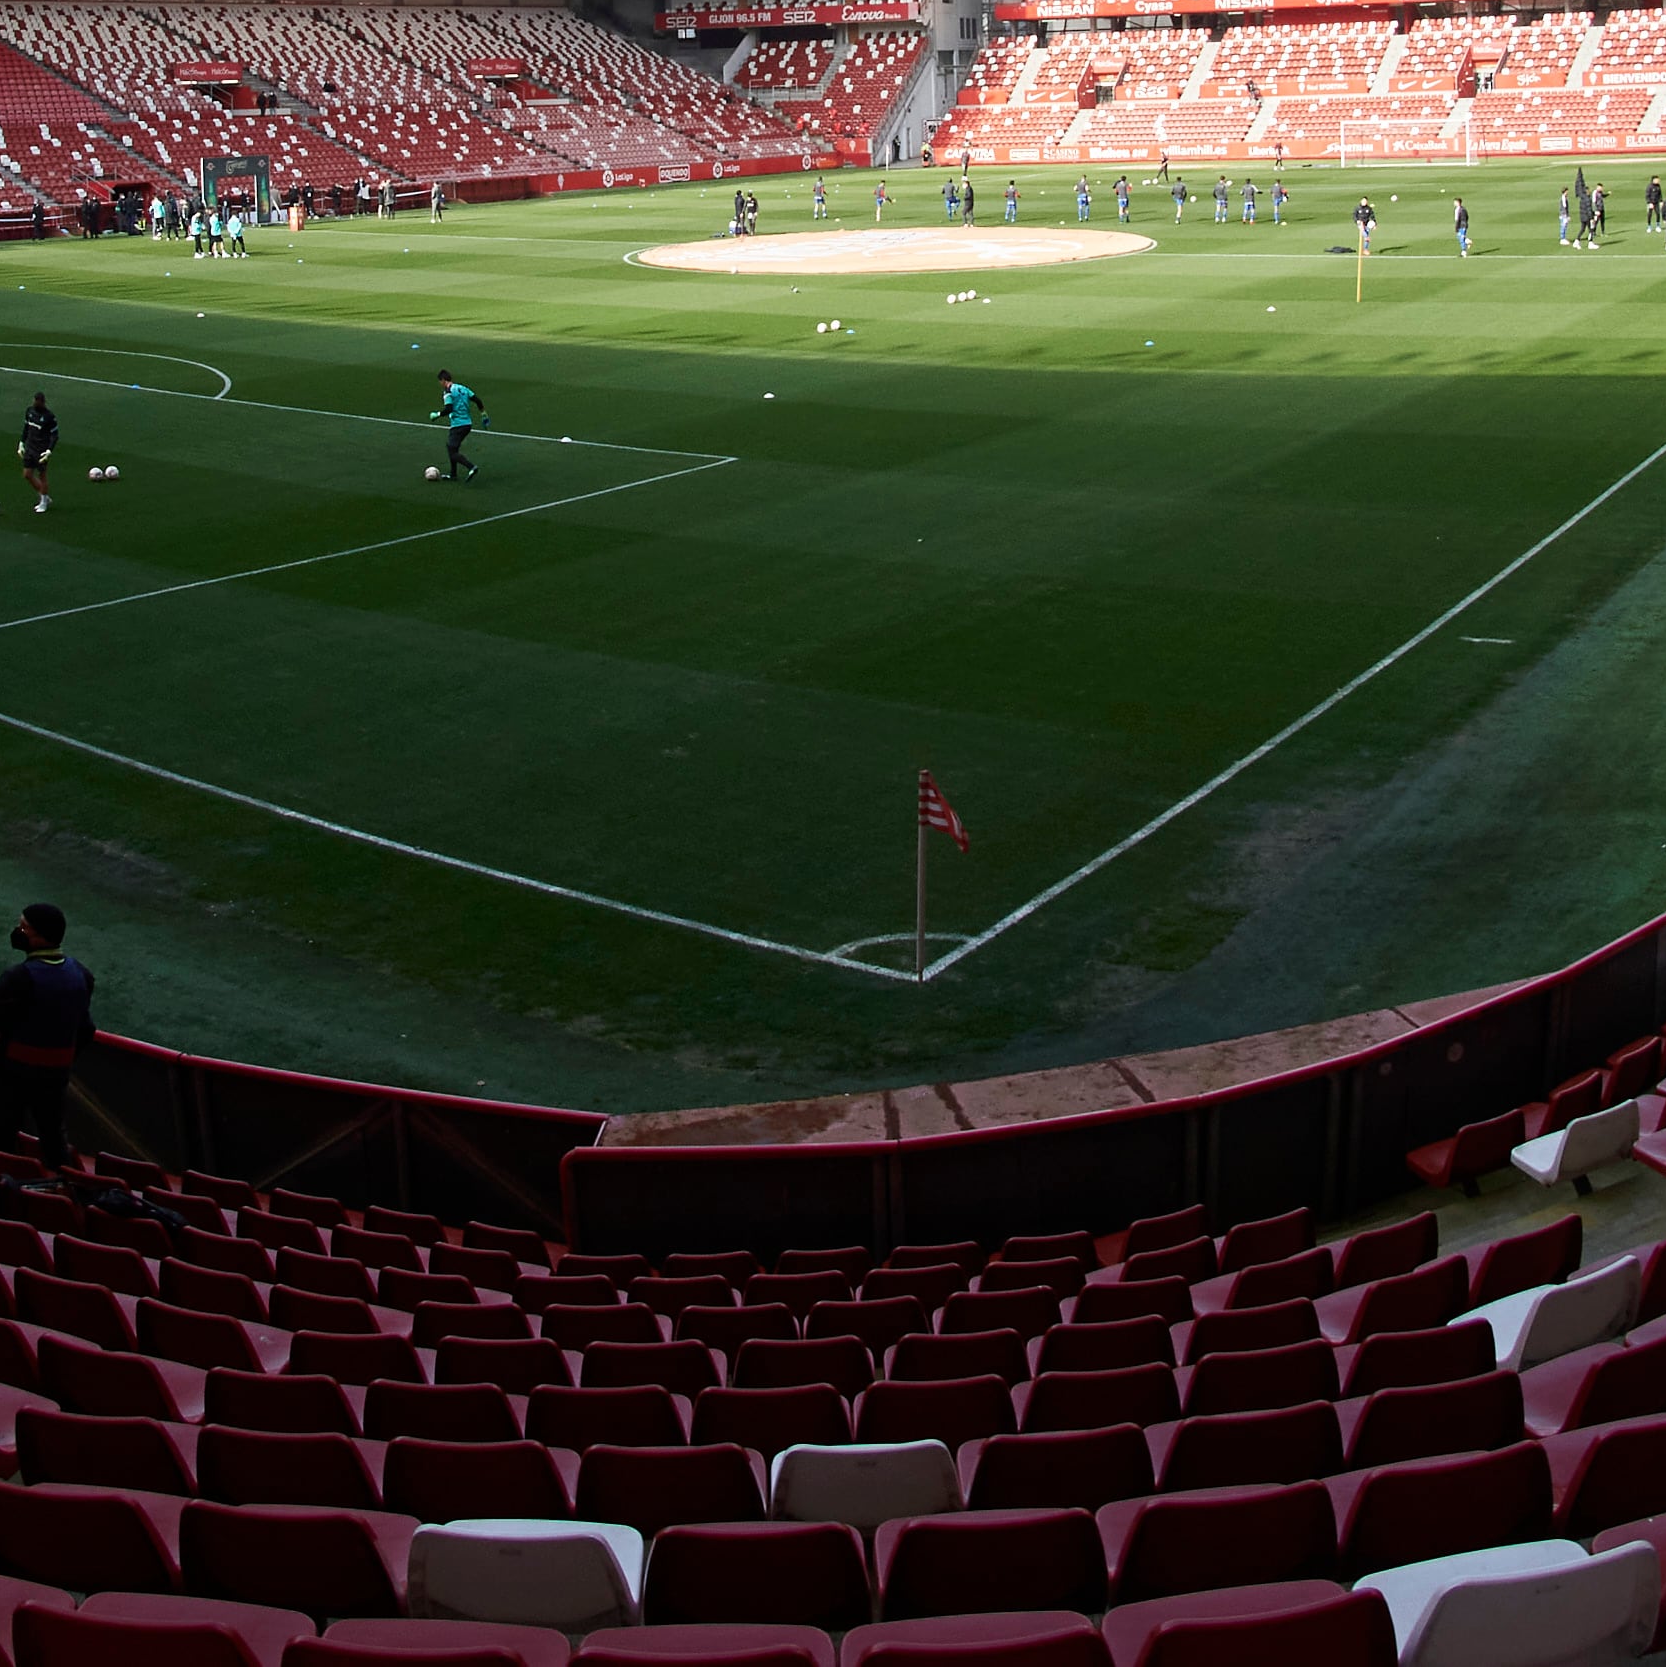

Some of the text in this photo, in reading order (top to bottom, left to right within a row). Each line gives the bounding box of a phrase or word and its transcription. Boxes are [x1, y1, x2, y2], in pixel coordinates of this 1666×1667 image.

[841, 5, 884, 21] Esnova
[1036, 5, 1094, 17] NISSAN
[1135, 1, 1173, 14] Cyasa
[737, 13, 755, 23] 96.5
[758, 12, 771, 22] FM
[1625, 136, 1636, 145] EL
[1160, 145, 1227, 156] williamhill.es
[615, 173, 633, 182] LaLiga
